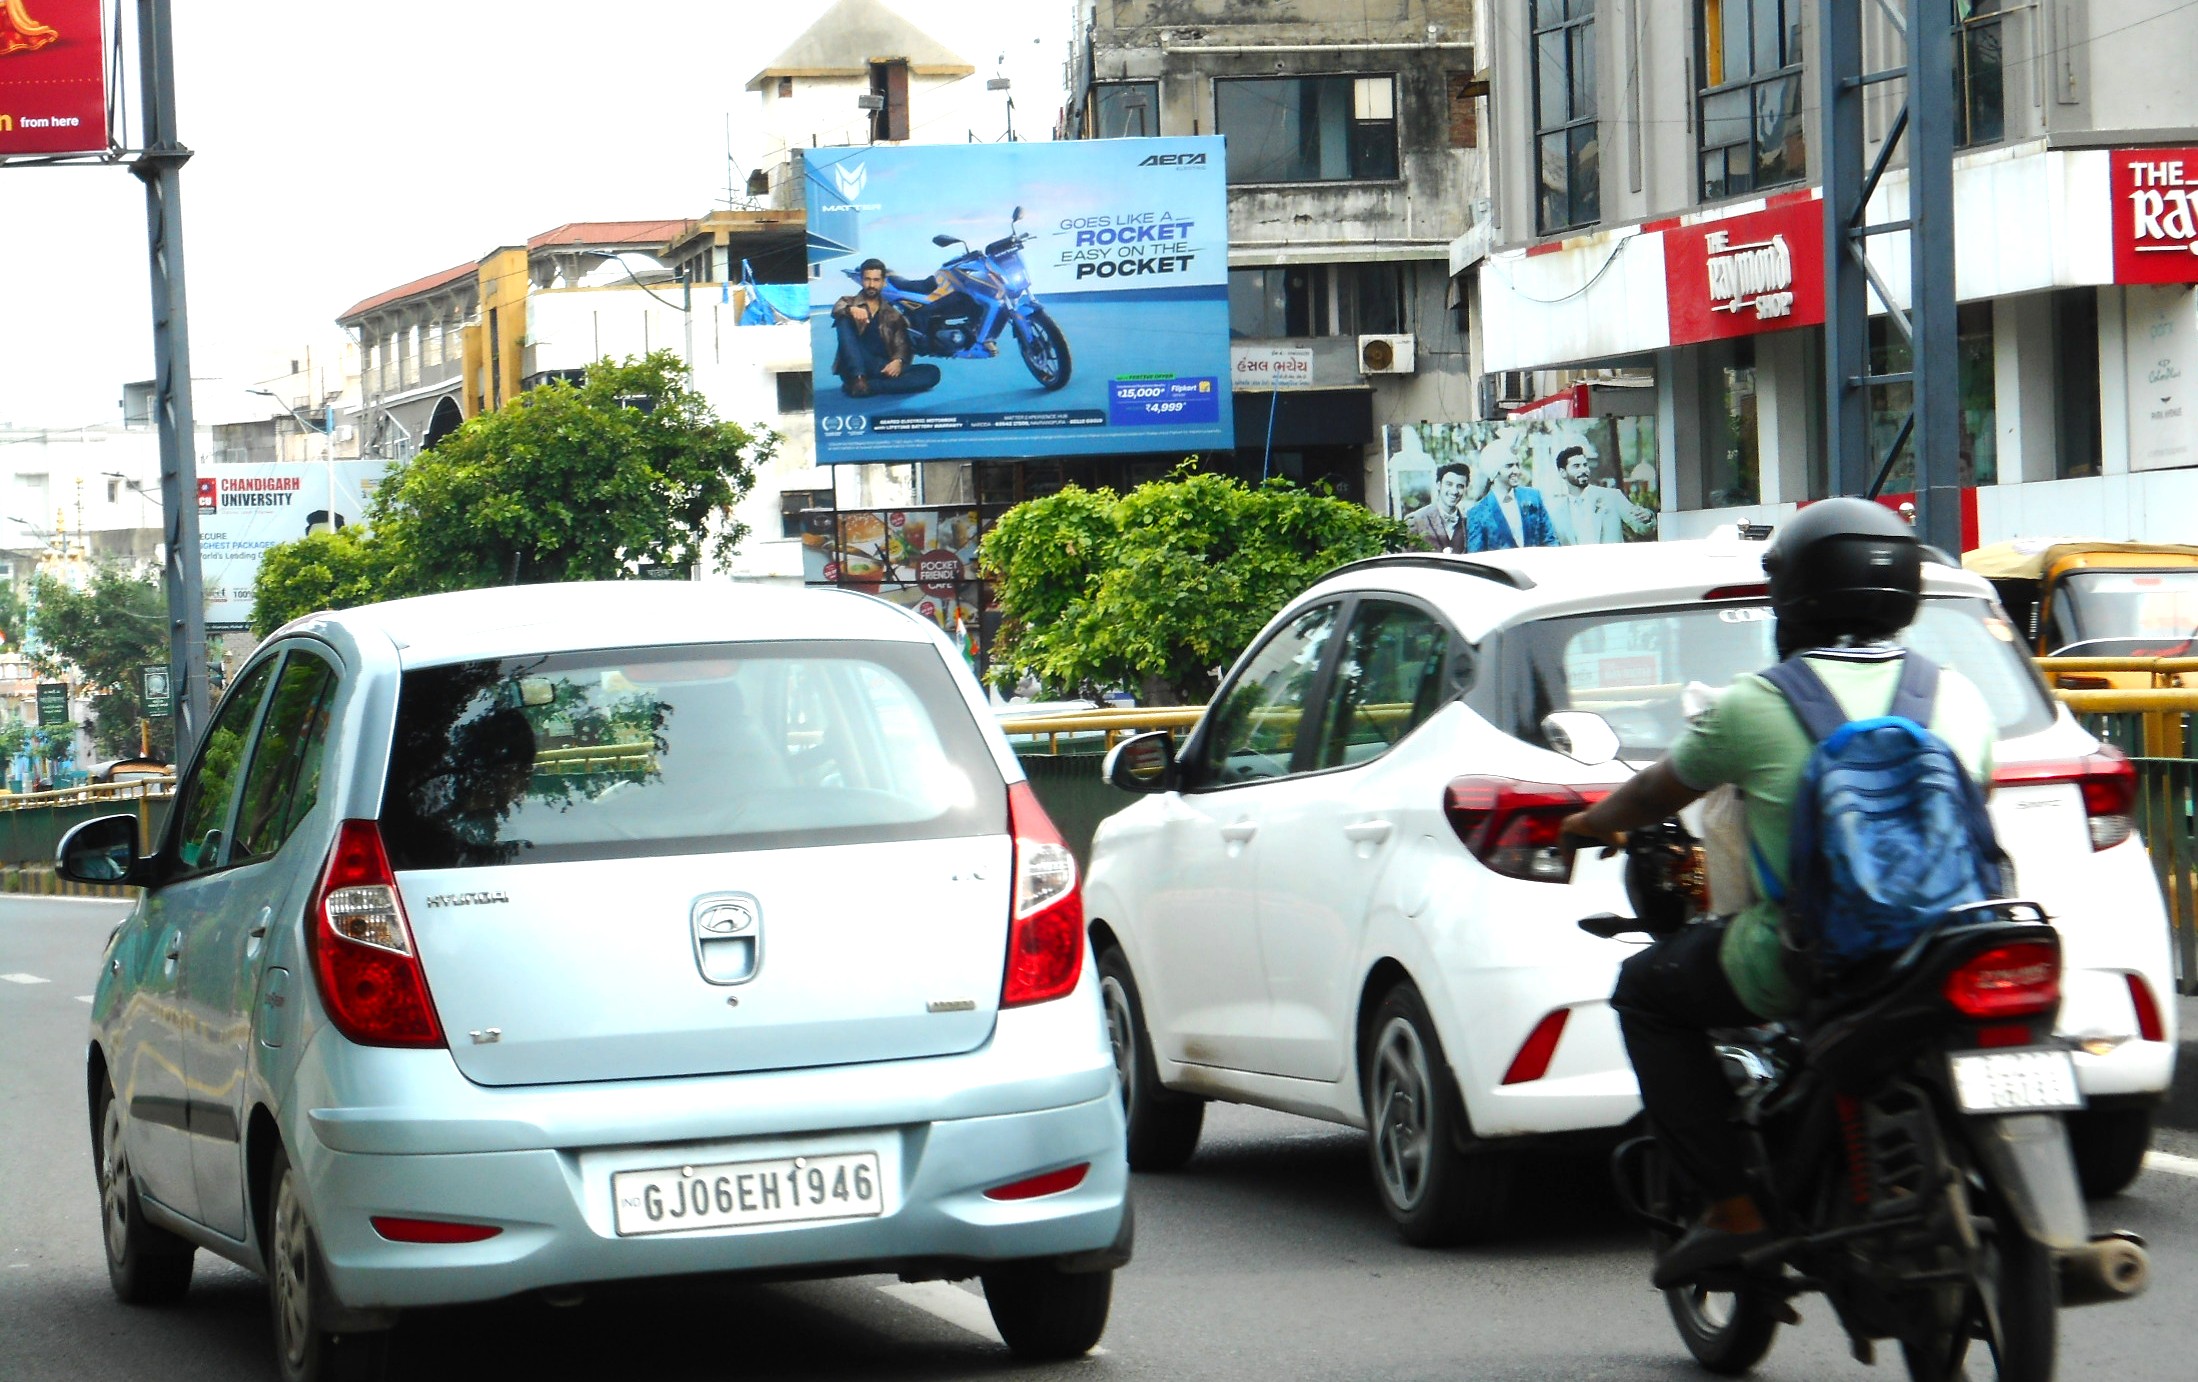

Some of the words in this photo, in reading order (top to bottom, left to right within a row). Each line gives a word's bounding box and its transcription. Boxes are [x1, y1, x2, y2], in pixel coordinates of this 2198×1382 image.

[20, 116, 50, 128] from
[51, 116, 80, 127] here
[2128, 161, 2184, 187] THE
[822, 203, 882, 213] MATTER
[1060, 215, 1111, 231] GOES
[1116, 211, 1155, 227] LIKE
[1160, 211, 1173, 223] A
[1076, 221, 1195, 248] ROCKET
[1704, 230, 1729, 255] THE
[1061, 247, 1113, 263] EASY
[1117, 245, 1145, 258] ON
[1150, 241, 1188, 255] THE
[1076, 254, 1195, 280] POCKET
[1171, 384, 1197, 393] Flipkart
[221, 478, 300, 491] CHANDIGARH
[221, 493, 293, 506] UNIVERSITY
[199, 532, 228, 541] ECURE
[200, 552, 223, 560] orld's
[225, 551, 257, 561] Leading
[920, 560, 959, 571] POCKET
[920, 569, 960, 580] FRIENDL
[426, 891, 509, 909] HYUNDAI
[643, 1163, 873, 1222] GJ06EH1946
